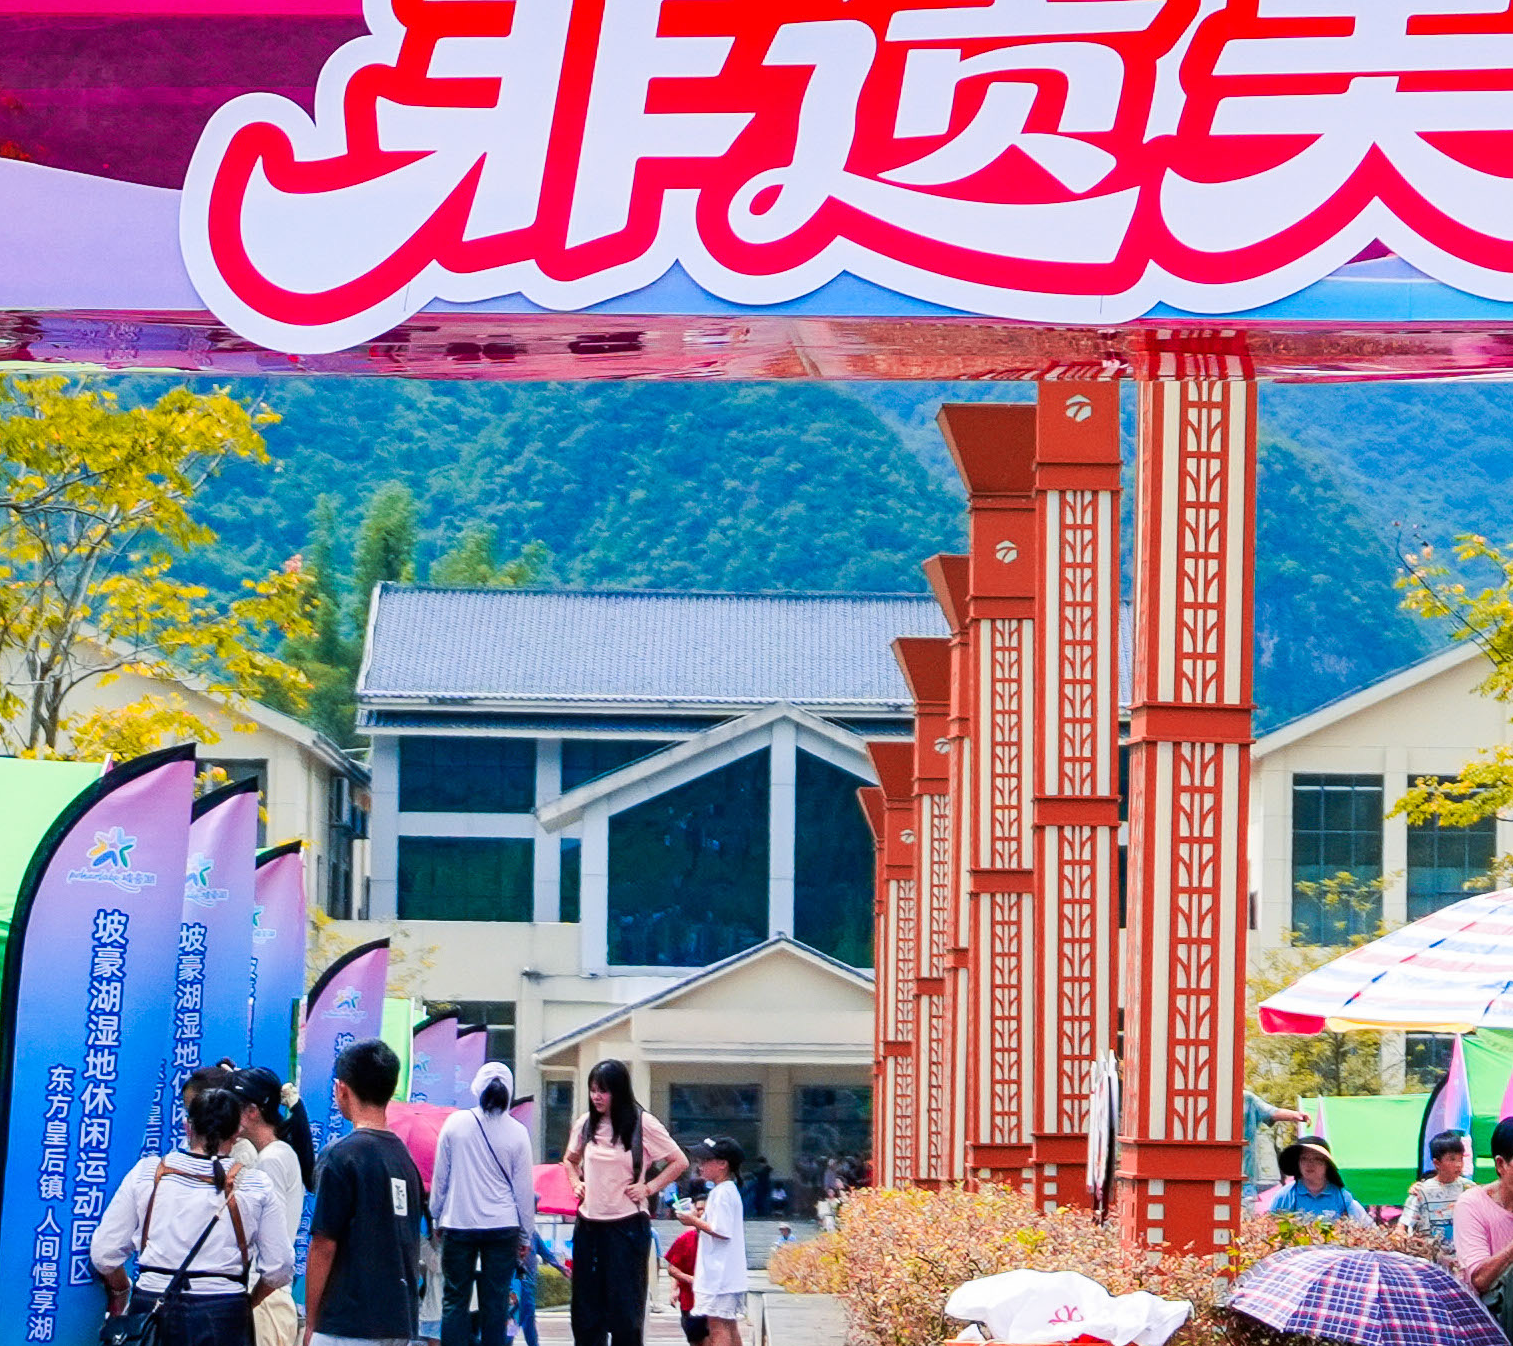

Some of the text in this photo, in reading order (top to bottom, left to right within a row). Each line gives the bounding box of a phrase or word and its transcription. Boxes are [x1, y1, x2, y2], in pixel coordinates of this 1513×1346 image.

[28, 1067, 74, 1341] 东方皇后镇 人间慢享湖
[70, 911, 127, 1285] 坡豪湖湿地休闲运动园区
